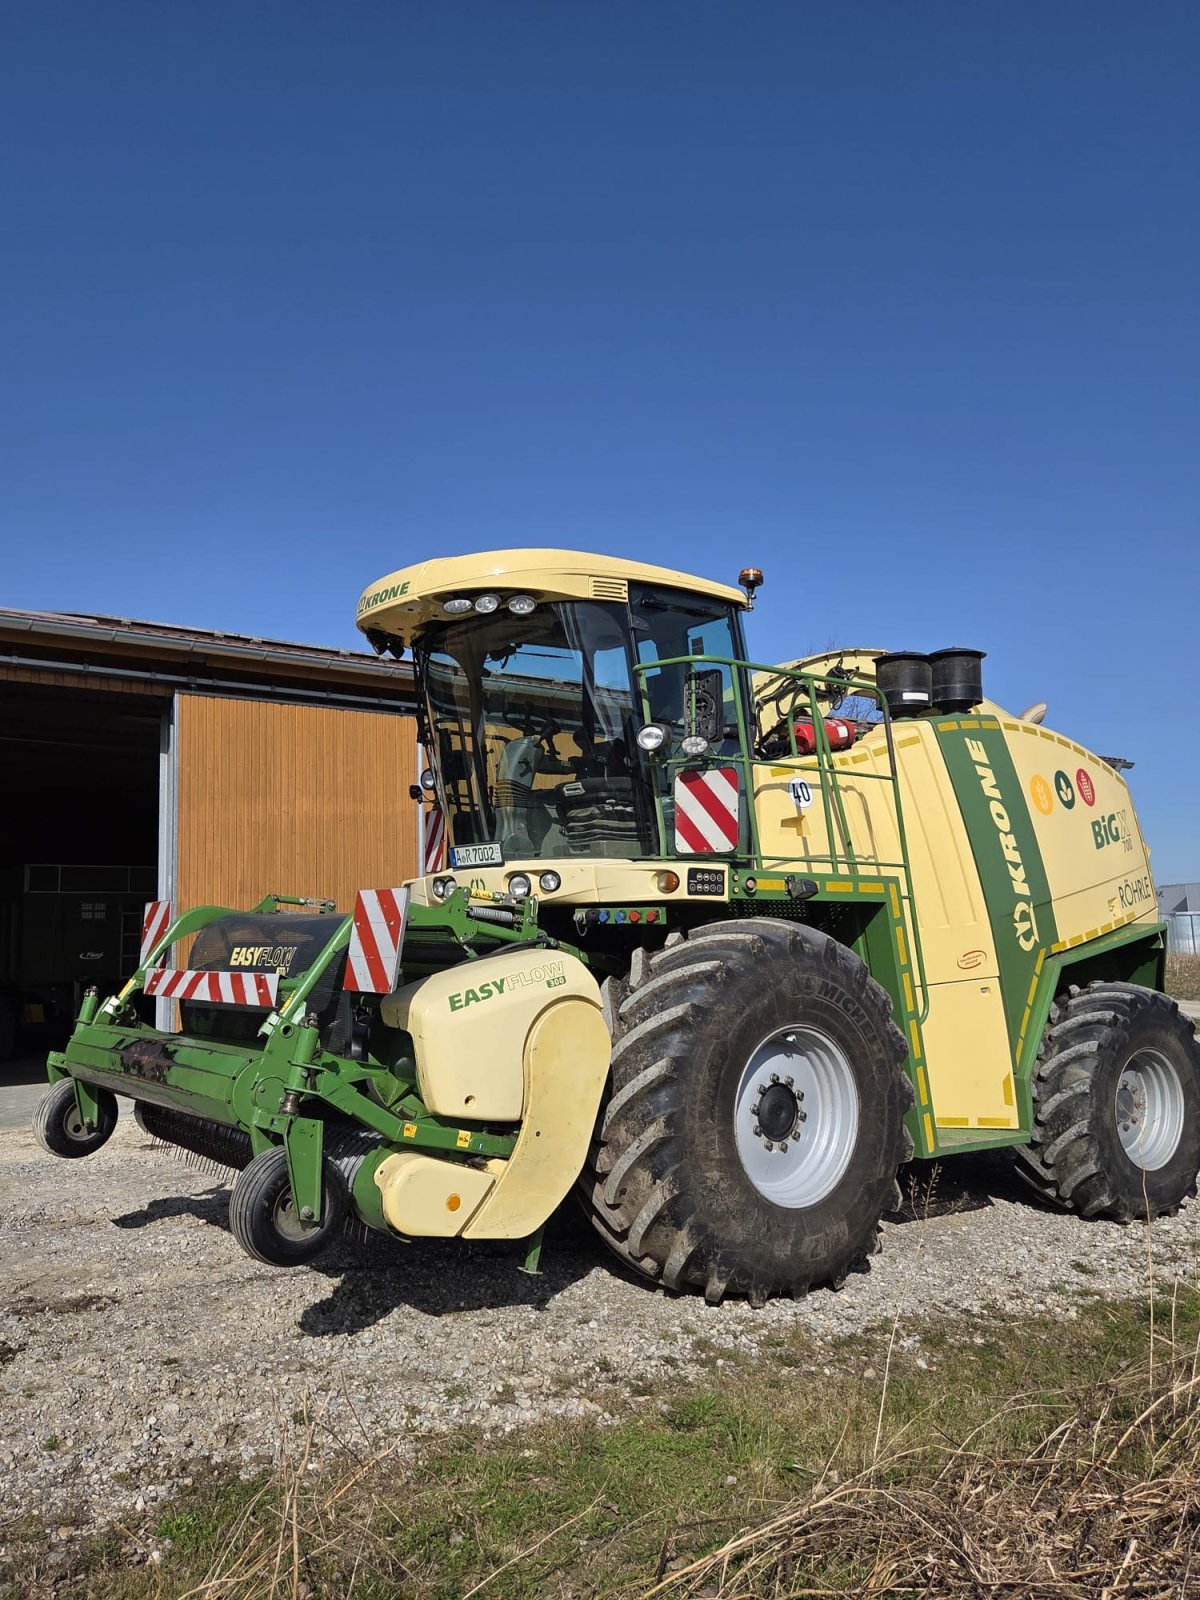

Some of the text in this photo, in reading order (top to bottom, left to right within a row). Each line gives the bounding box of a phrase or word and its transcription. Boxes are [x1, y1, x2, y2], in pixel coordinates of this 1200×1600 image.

[365, 581, 411, 610] KRONE
[791, 782, 811, 803] 40
[964, 737, 1031, 896] KRONE
[472, 846, 496, 863] 7002
[1118, 876, 1151, 908] RÖHRLE
[229, 946, 298, 967] EASYFLOW
[448, 961, 565, 1012] EASYFLOW
[548, 976, 566, 988] 300
